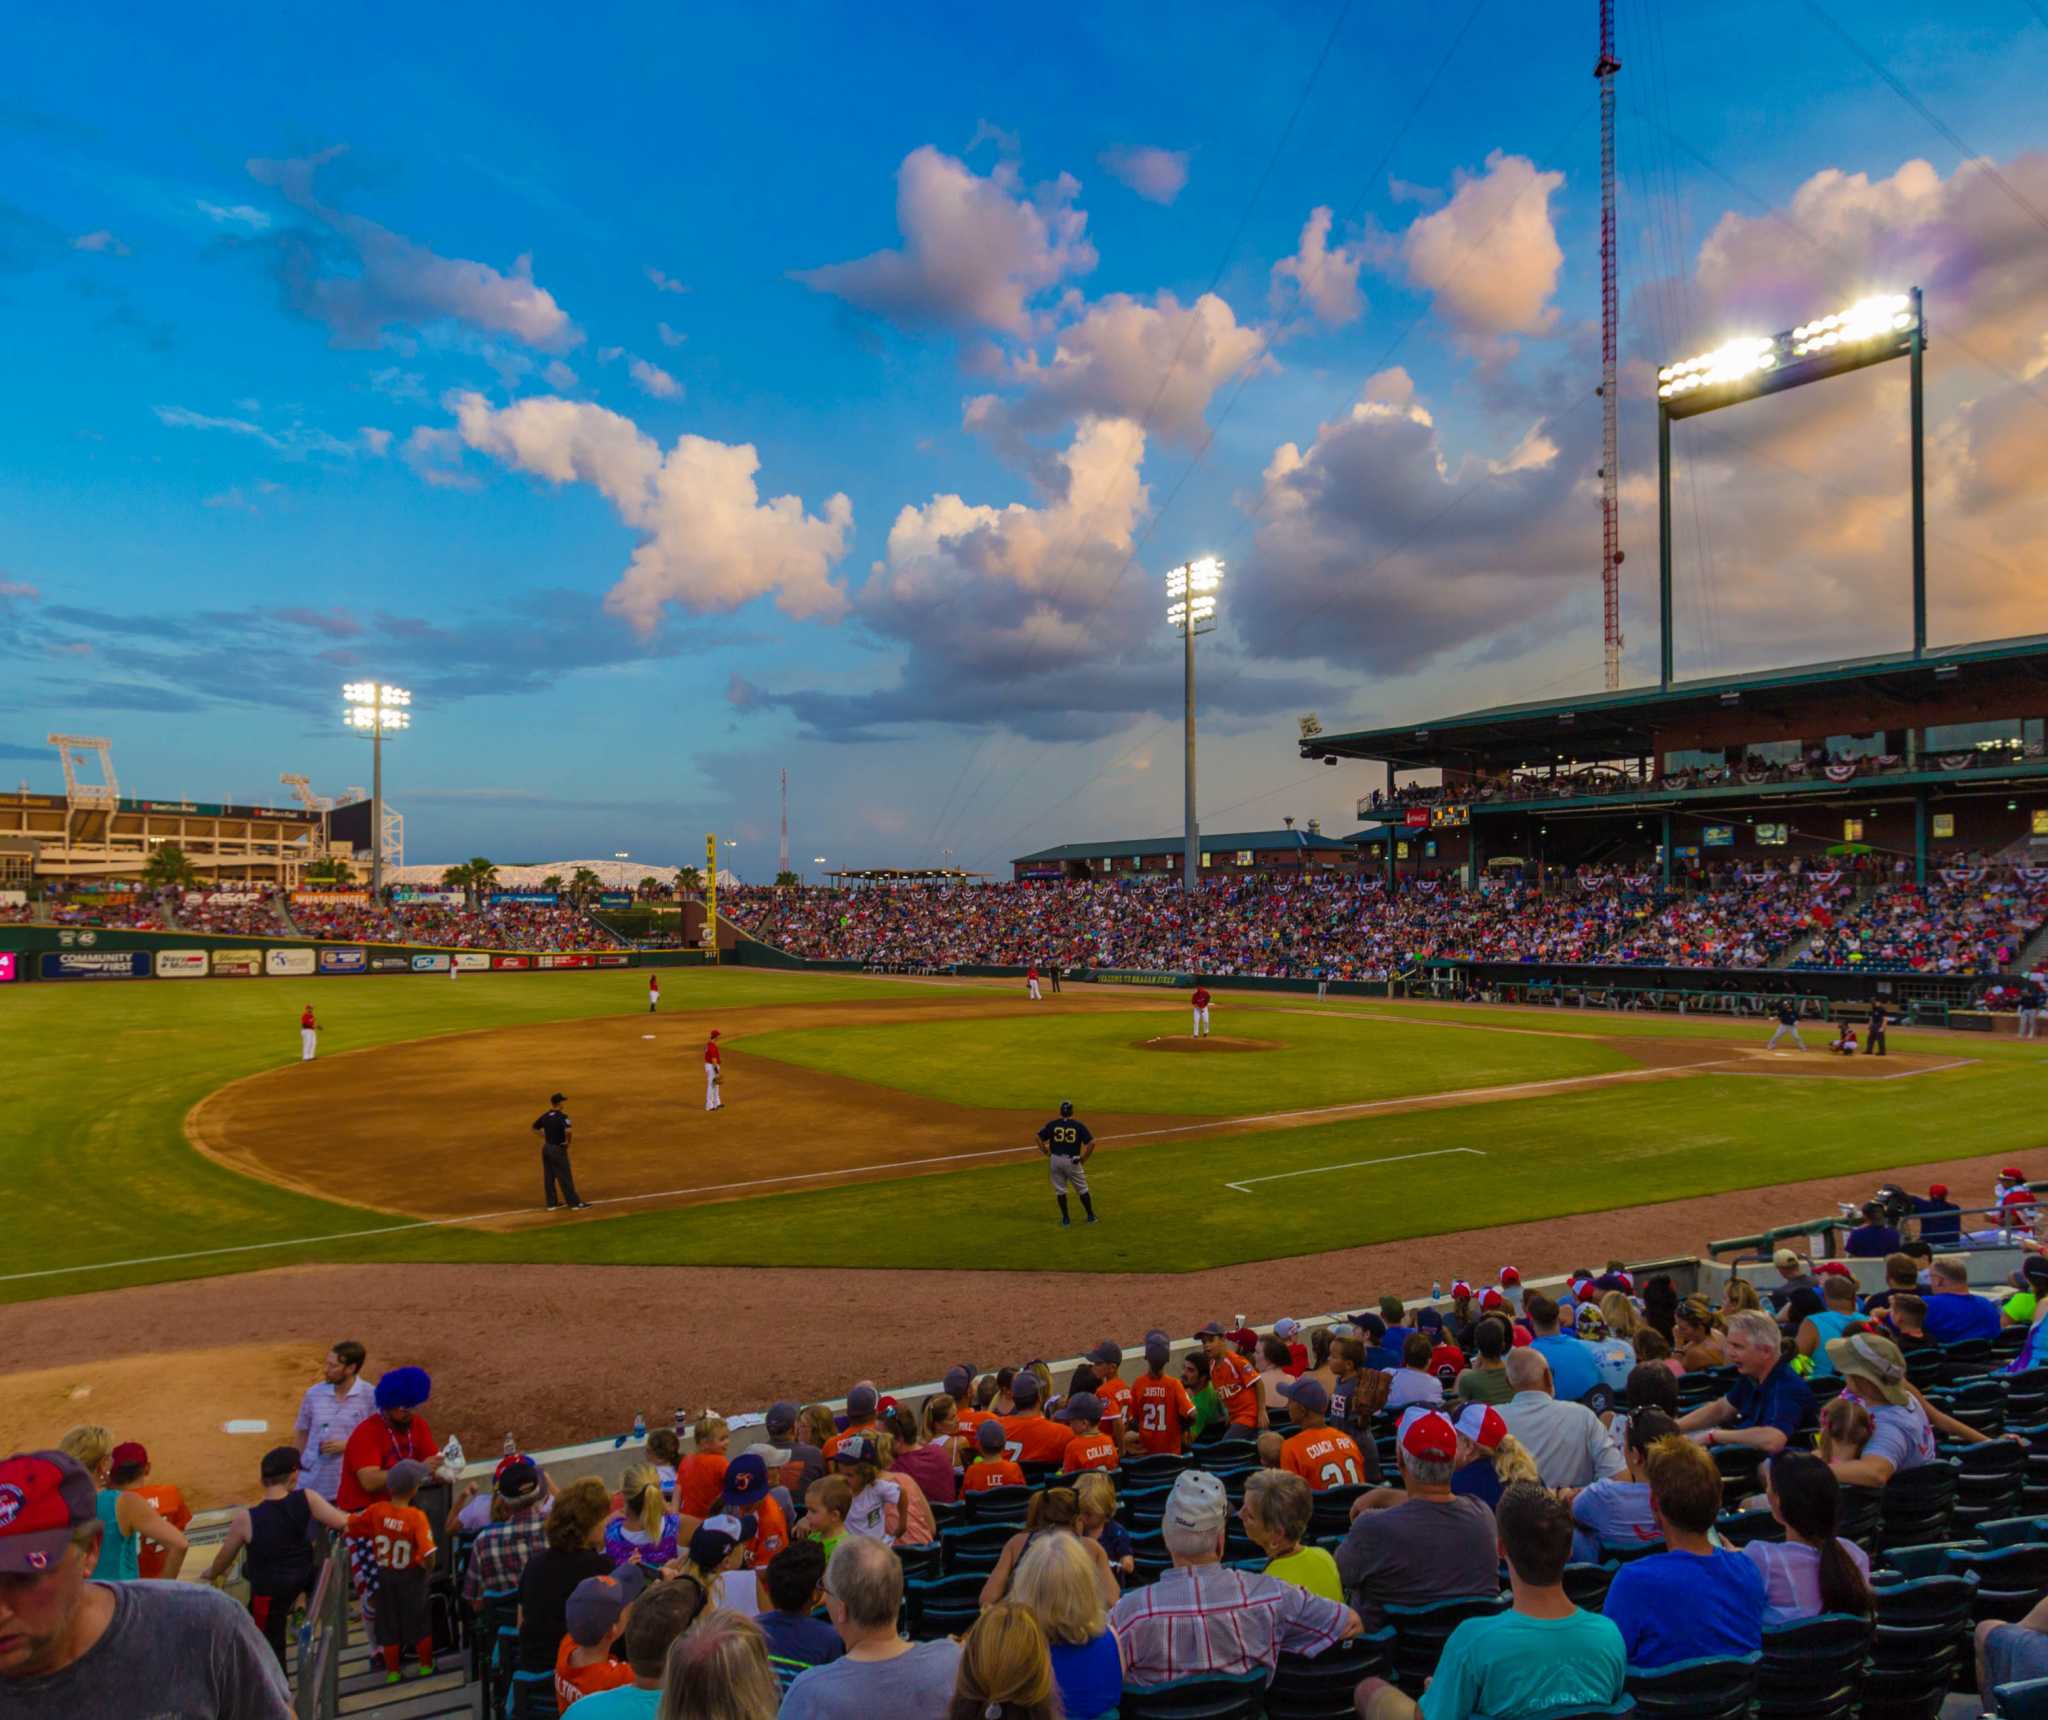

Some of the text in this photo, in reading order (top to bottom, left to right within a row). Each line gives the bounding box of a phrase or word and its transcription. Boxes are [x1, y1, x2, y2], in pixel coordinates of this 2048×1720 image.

[60, 953, 133, 962] COMMUNITY
[102, 962, 133, 971] FIRST
[1054, 1127, 1076, 1143] 33
[1143, 1386, 1165, 1397] JUSTO
[1143, 1403, 1167, 1432] 21
[1004, 1440, 1023, 1463] 7
[1306, 1439, 1335, 1460] COACH
[986, 1474, 1003, 1487] LEE
[375, 1535, 411, 1570] 20
